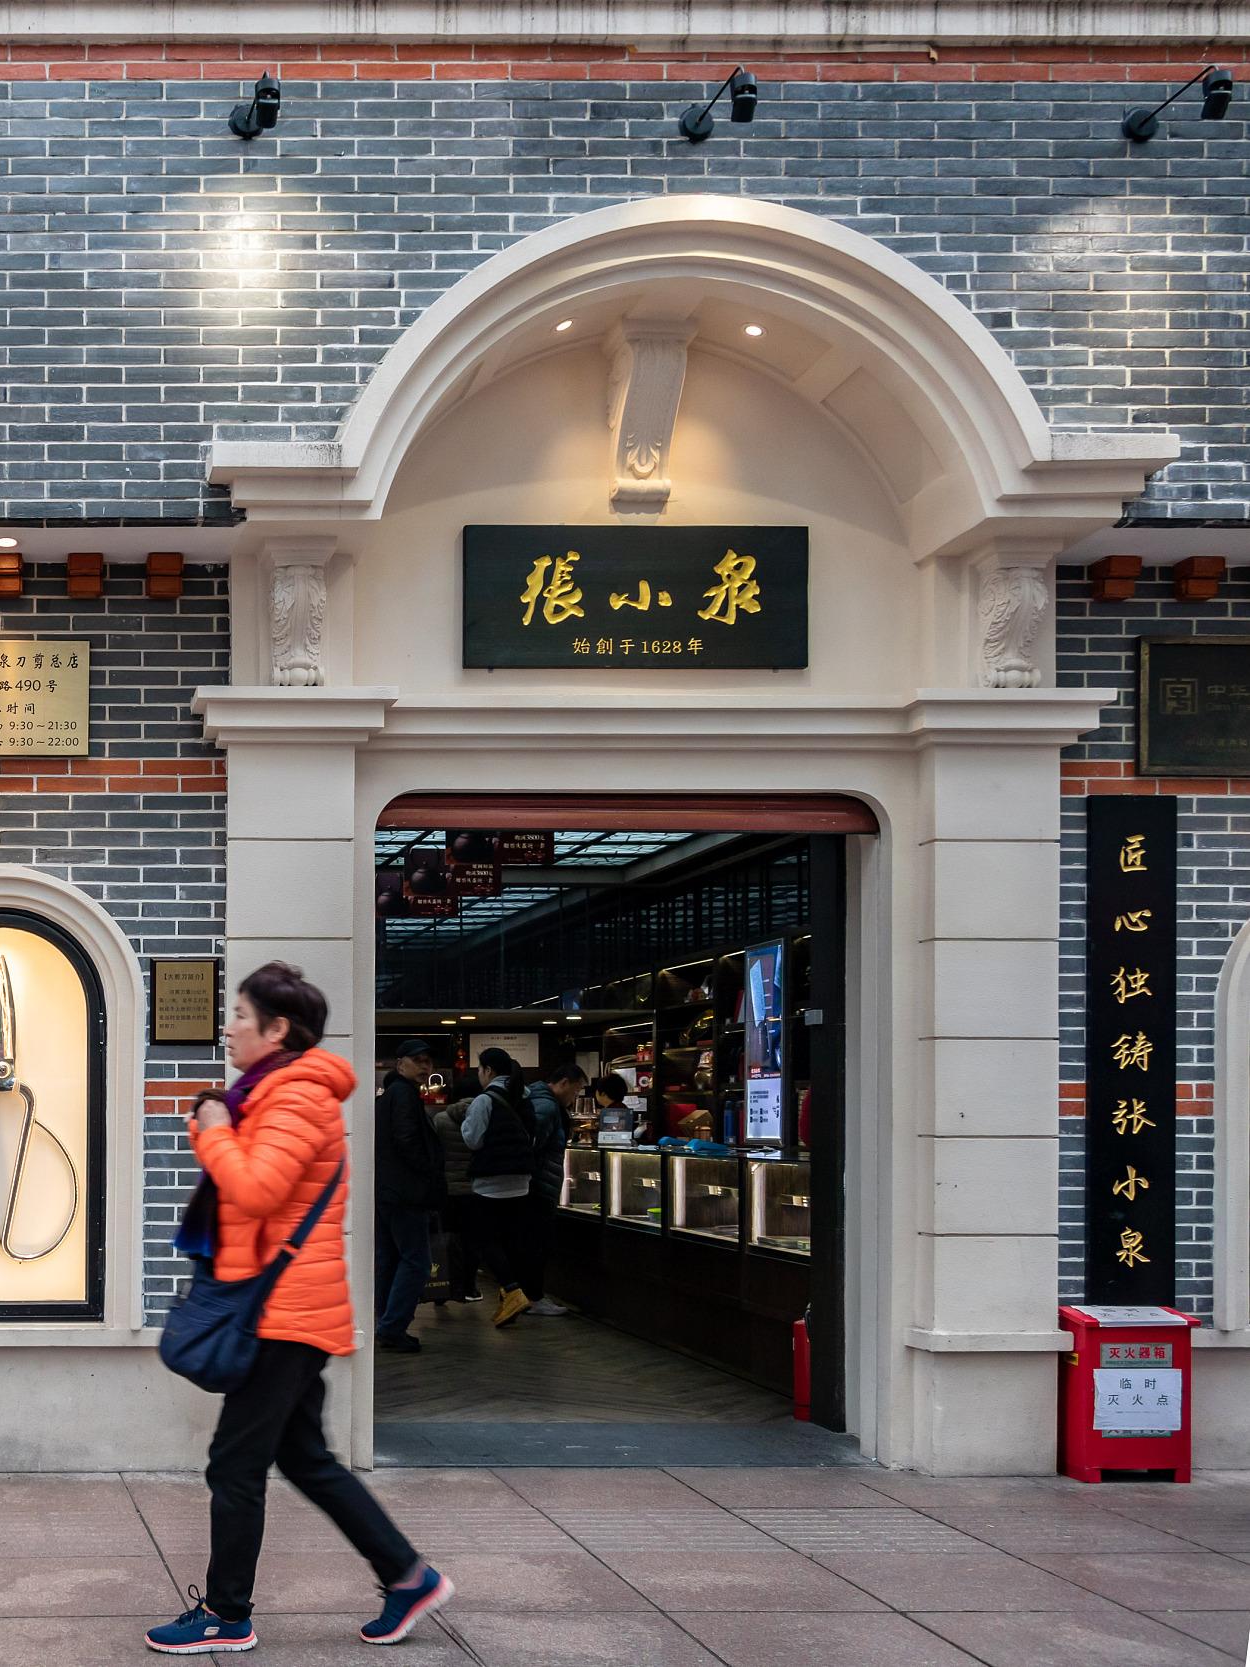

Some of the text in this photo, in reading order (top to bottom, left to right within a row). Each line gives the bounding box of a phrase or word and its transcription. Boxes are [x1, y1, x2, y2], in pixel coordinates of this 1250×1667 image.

[572, 637, 704, 655] 始創于1628年
[1110, 834, 1157, 1268] 匠心独铸张小泉
[1109, 1347, 1167, 1359] 灭火器箱
[1107, 1394, 1169, 1406] 灭火点
